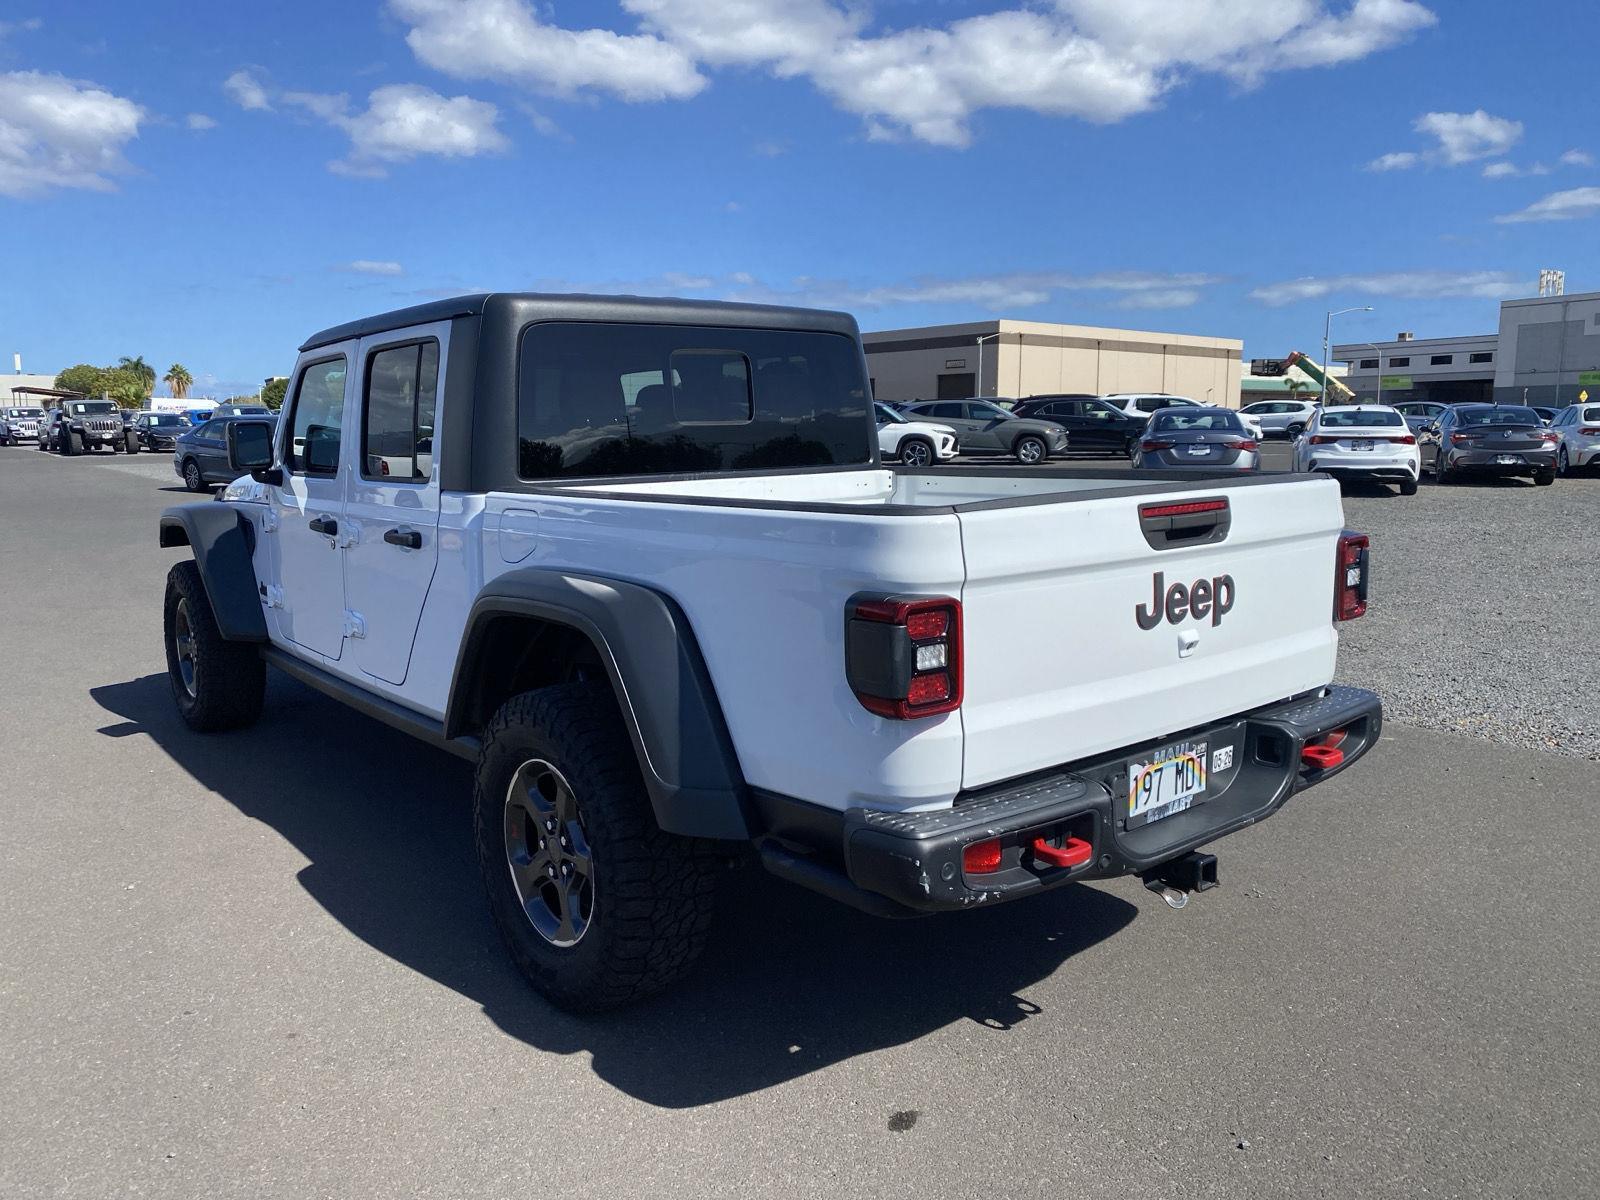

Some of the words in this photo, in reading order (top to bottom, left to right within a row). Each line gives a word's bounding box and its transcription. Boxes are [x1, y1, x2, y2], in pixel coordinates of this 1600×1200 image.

[1136, 571, 1235, 630] Jeep
[1133, 767, 1164, 810] 197
[1175, 753, 1206, 795] MDT
